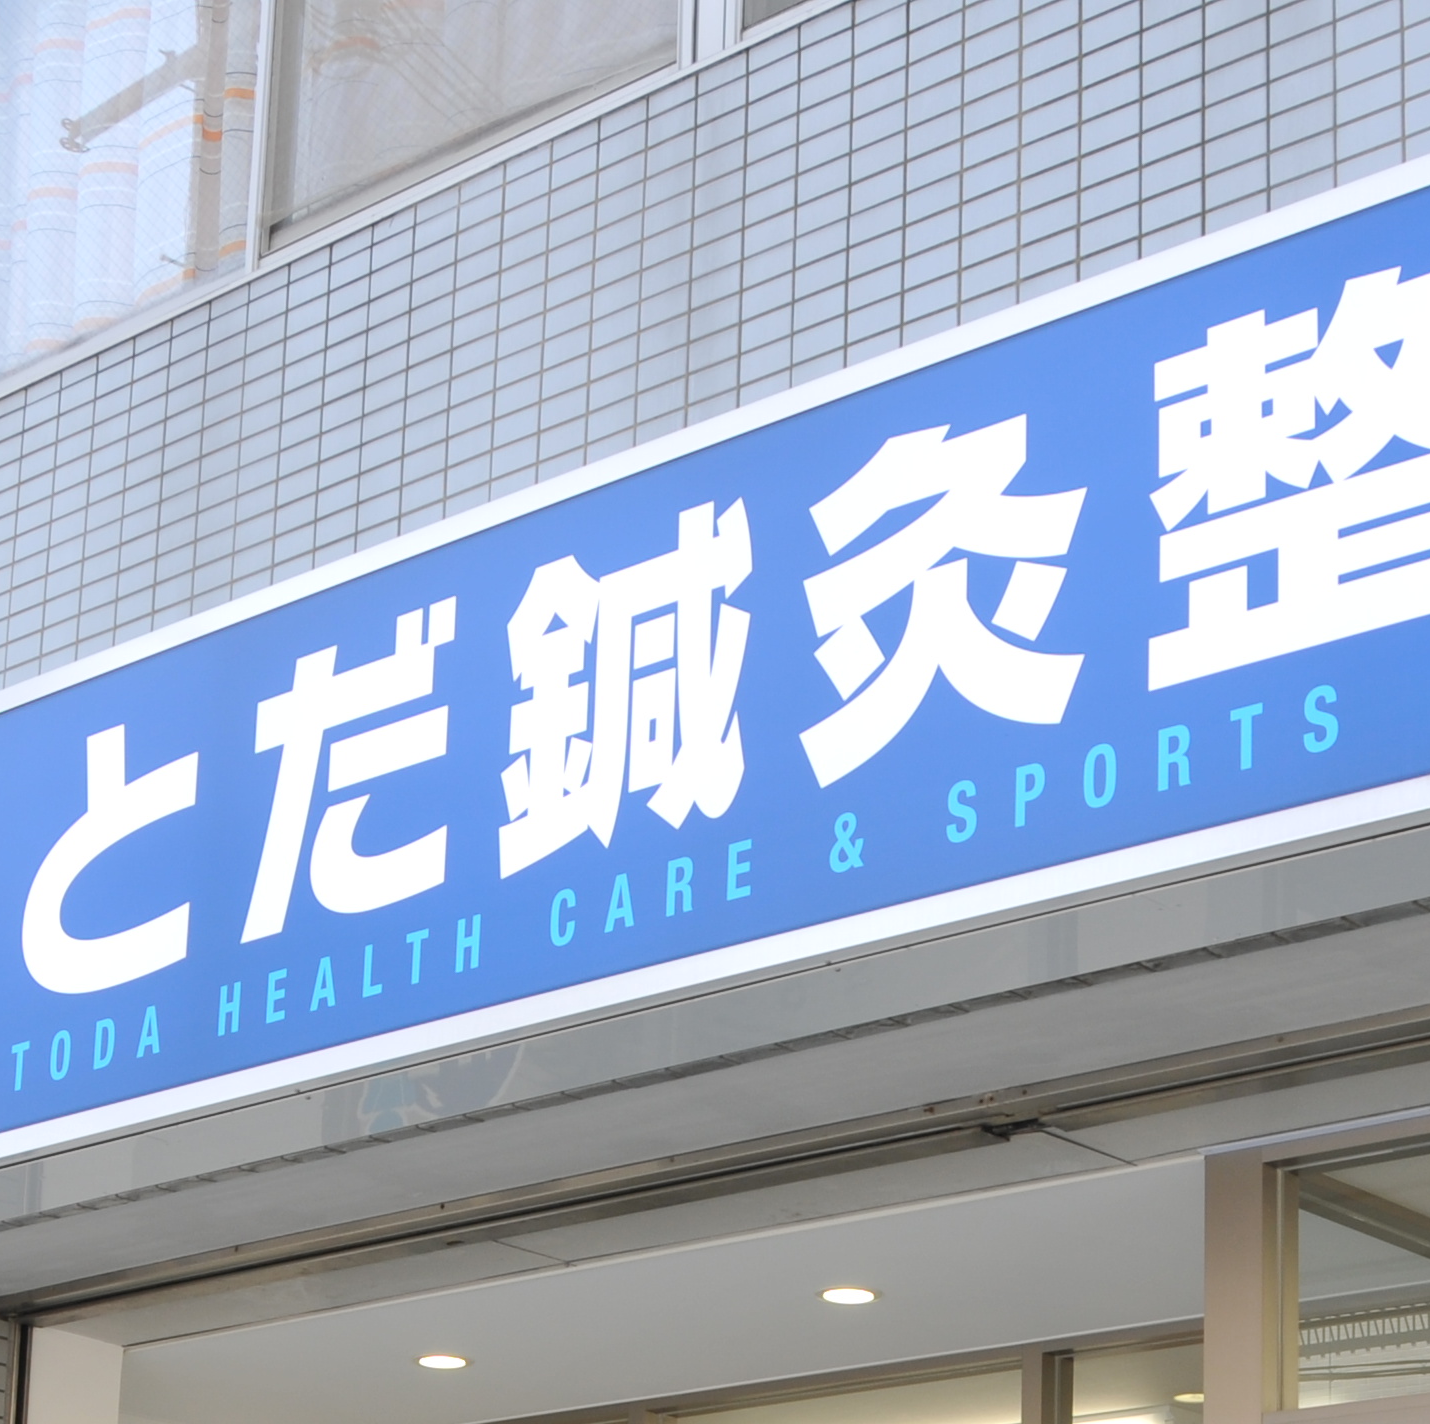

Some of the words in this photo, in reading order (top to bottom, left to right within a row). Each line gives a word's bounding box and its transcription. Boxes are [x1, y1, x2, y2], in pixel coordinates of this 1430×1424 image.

[11, 1005, 161, 1091] TODA
[217, 914, 482, 1036] HEALTH
[549, 839, 753, 947] CARE
[828, 812, 865, 873] &
[946, 684, 1339, 842] SPORTS
